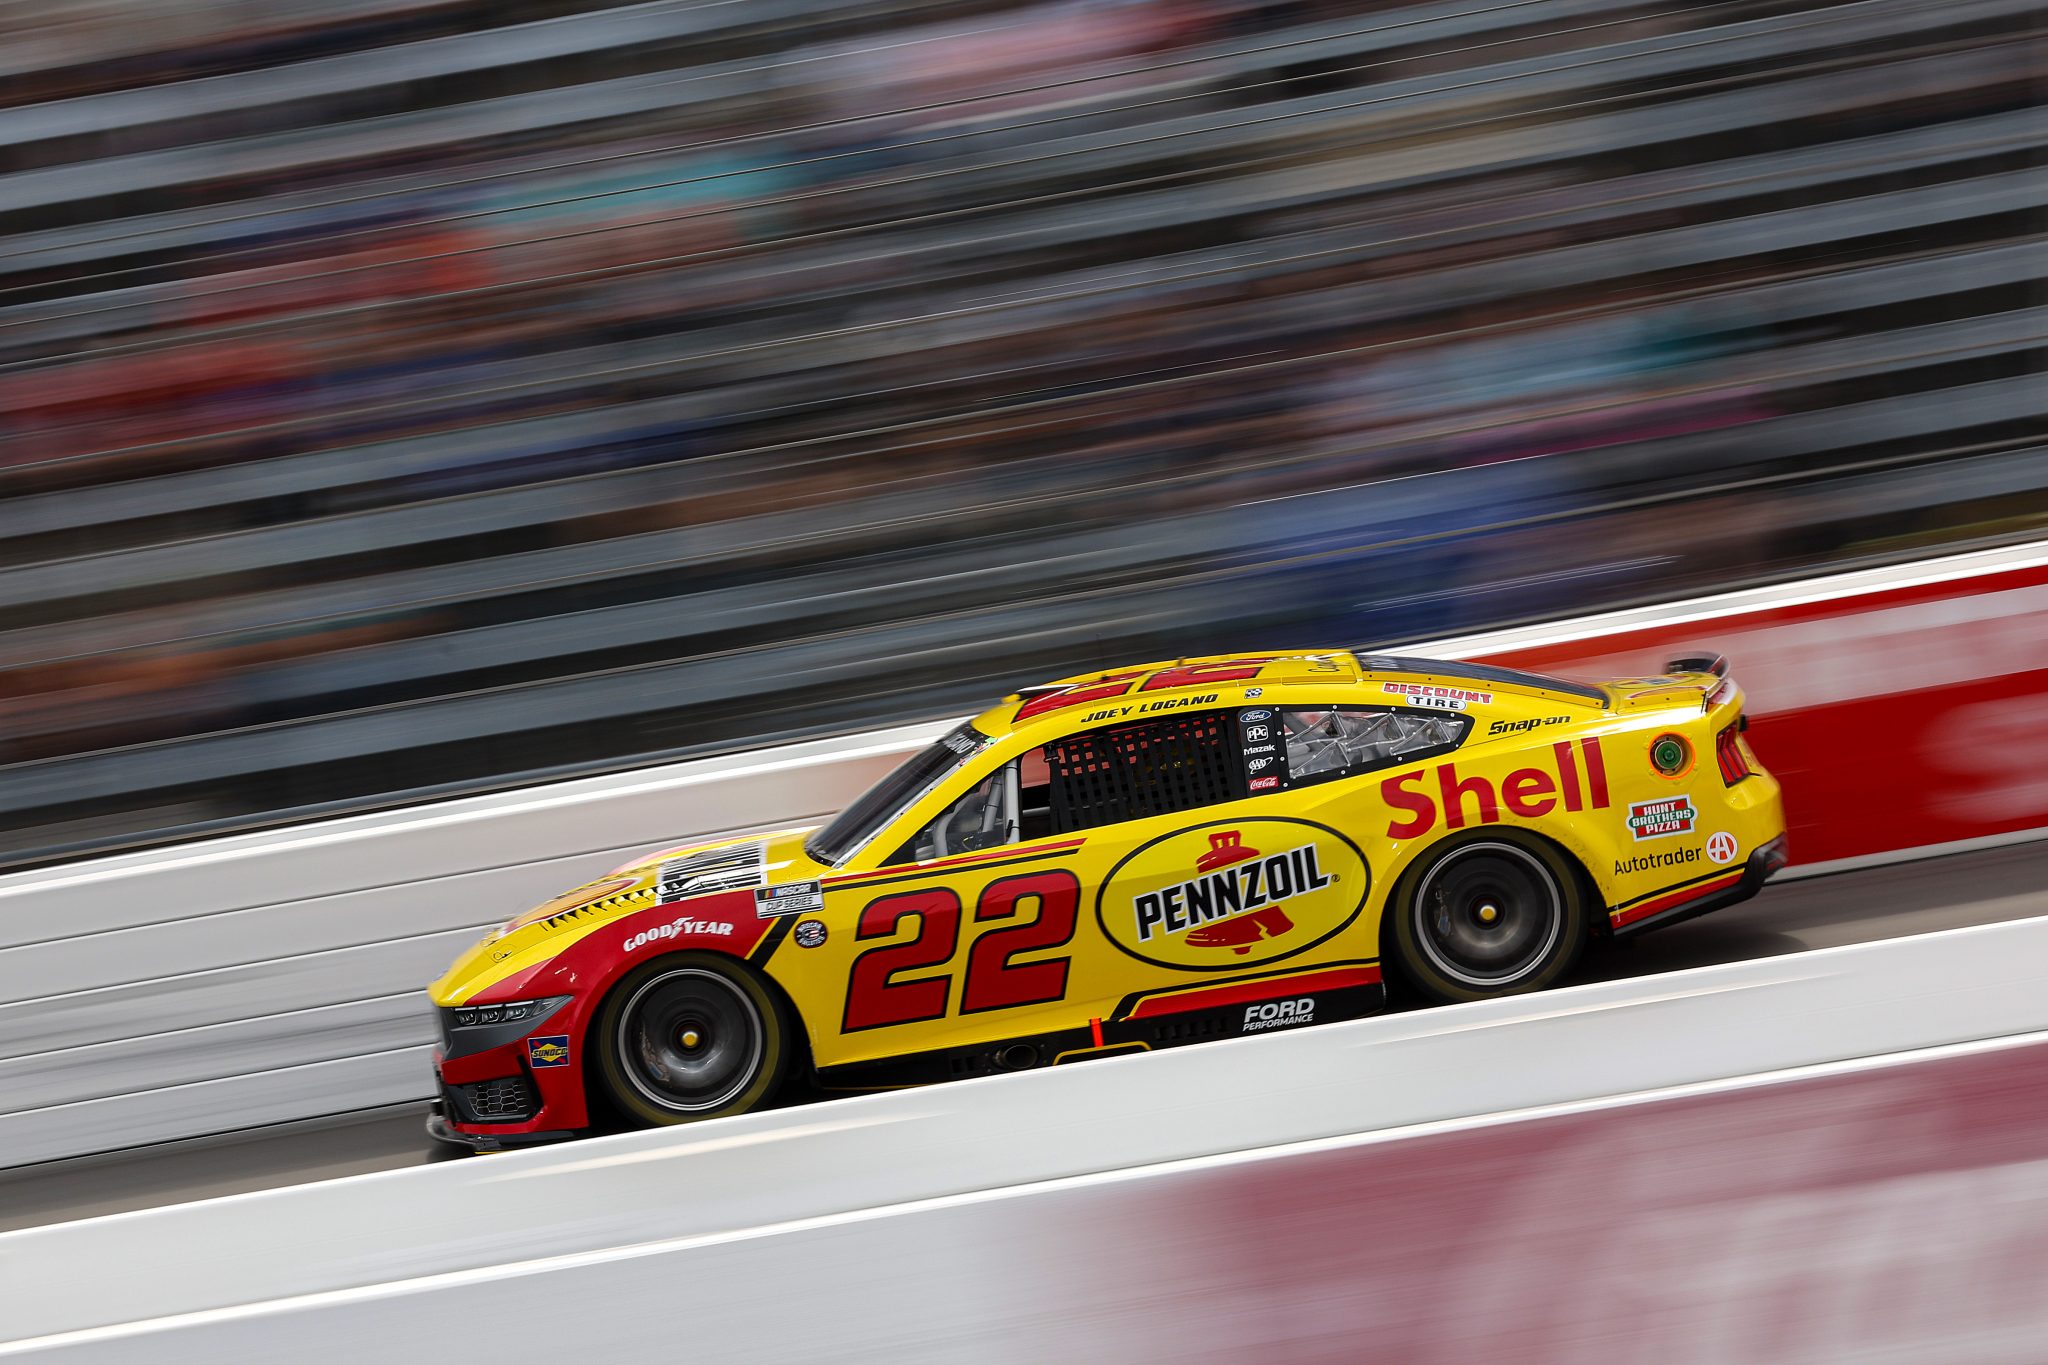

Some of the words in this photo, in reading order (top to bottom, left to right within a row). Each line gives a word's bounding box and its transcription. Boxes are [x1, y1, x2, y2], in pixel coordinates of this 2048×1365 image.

[1383, 682, 1492, 704] DISCOUNT
[1081, 704, 1132, 723] JOEY
[1139, 693, 1218, 713] LOGANO
[1412, 696, 1460, 709] TIRE
[1245, 711, 1265, 721] Ford
[1248, 727, 1267, 740] PPG
[1488, 715, 1571, 736] Snap-on
[1243, 744, 1276, 756] Mazak
[1249, 759, 1266, 770] AAA
[1381, 736, 1610, 840] Shell
[1643, 802, 1676, 817] HUNT
[1632, 812, 1691, 828] BROTHERS
[1645, 819, 1680, 834] PIZZA
[1614, 846, 1702, 876] Autotrader
[775, 883, 812, 898] NASCAR
[1133, 842, 1332, 943] PENNZOIL
[766, 900, 783, 911] CUP
[784, 896, 813, 908] SERIES
[623, 916, 734, 952] GOODYEAR
[841, 869, 1081, 1034] 22
[1244, 998, 1315, 1023] FORD
[1242, 1013, 1314, 1032] PERFORMANCE
[532, 1047, 568, 1058] SUNOCO
